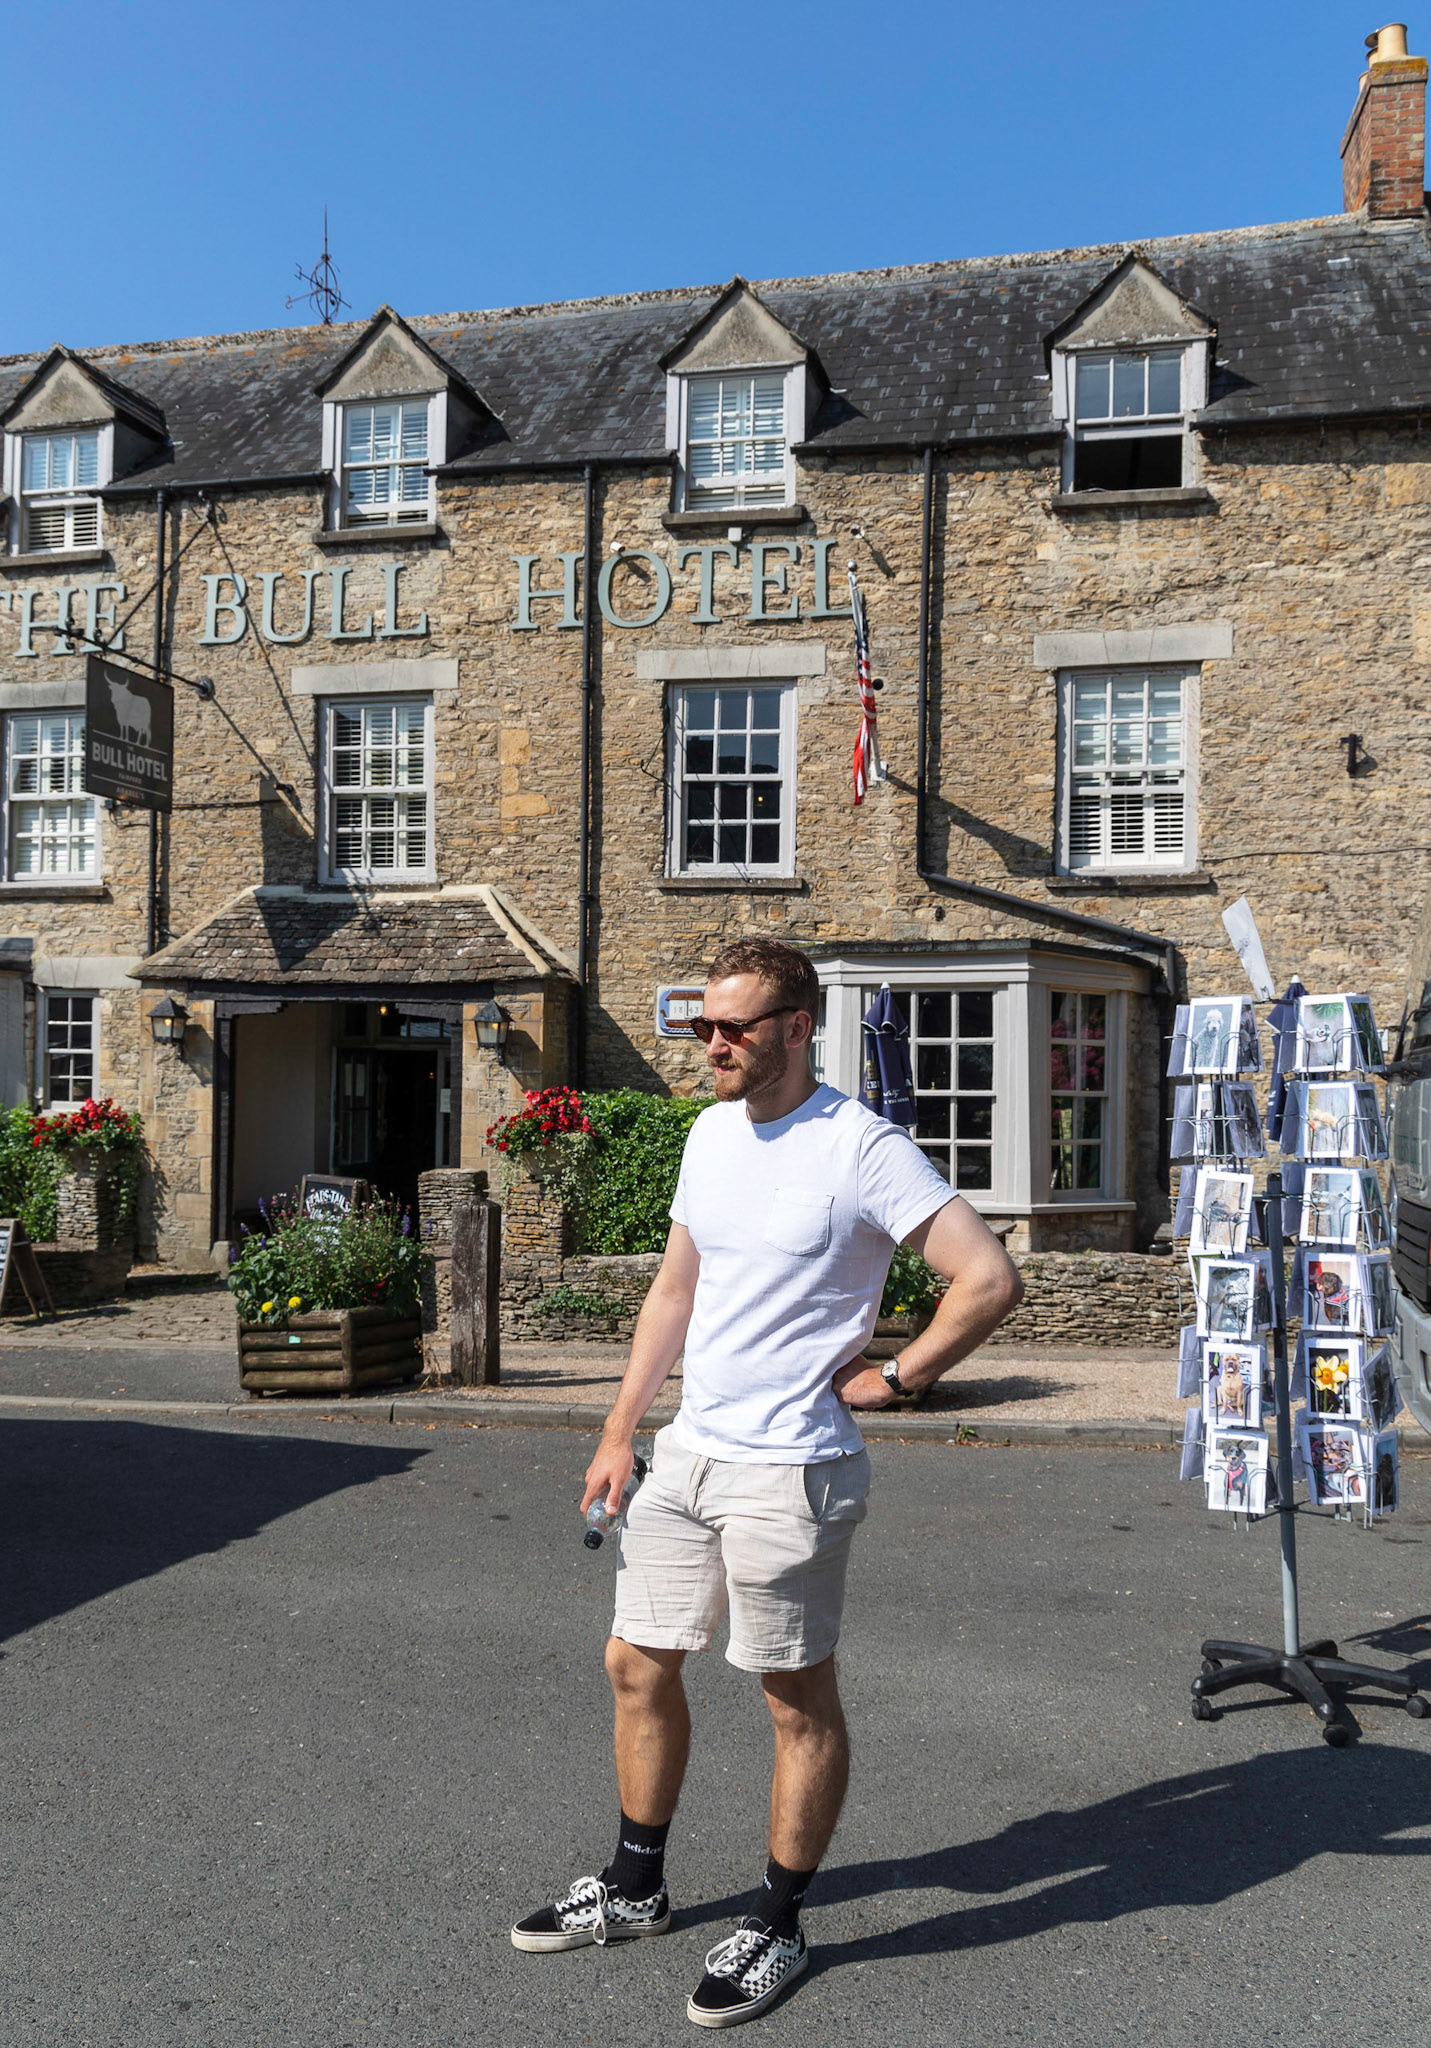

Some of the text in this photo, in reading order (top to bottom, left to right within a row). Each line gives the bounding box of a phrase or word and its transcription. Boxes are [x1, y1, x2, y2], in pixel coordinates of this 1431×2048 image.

[0, 539, 852, 657] HE BULL HOTEL
[92, 741, 168, 781] BULL HOTEL
